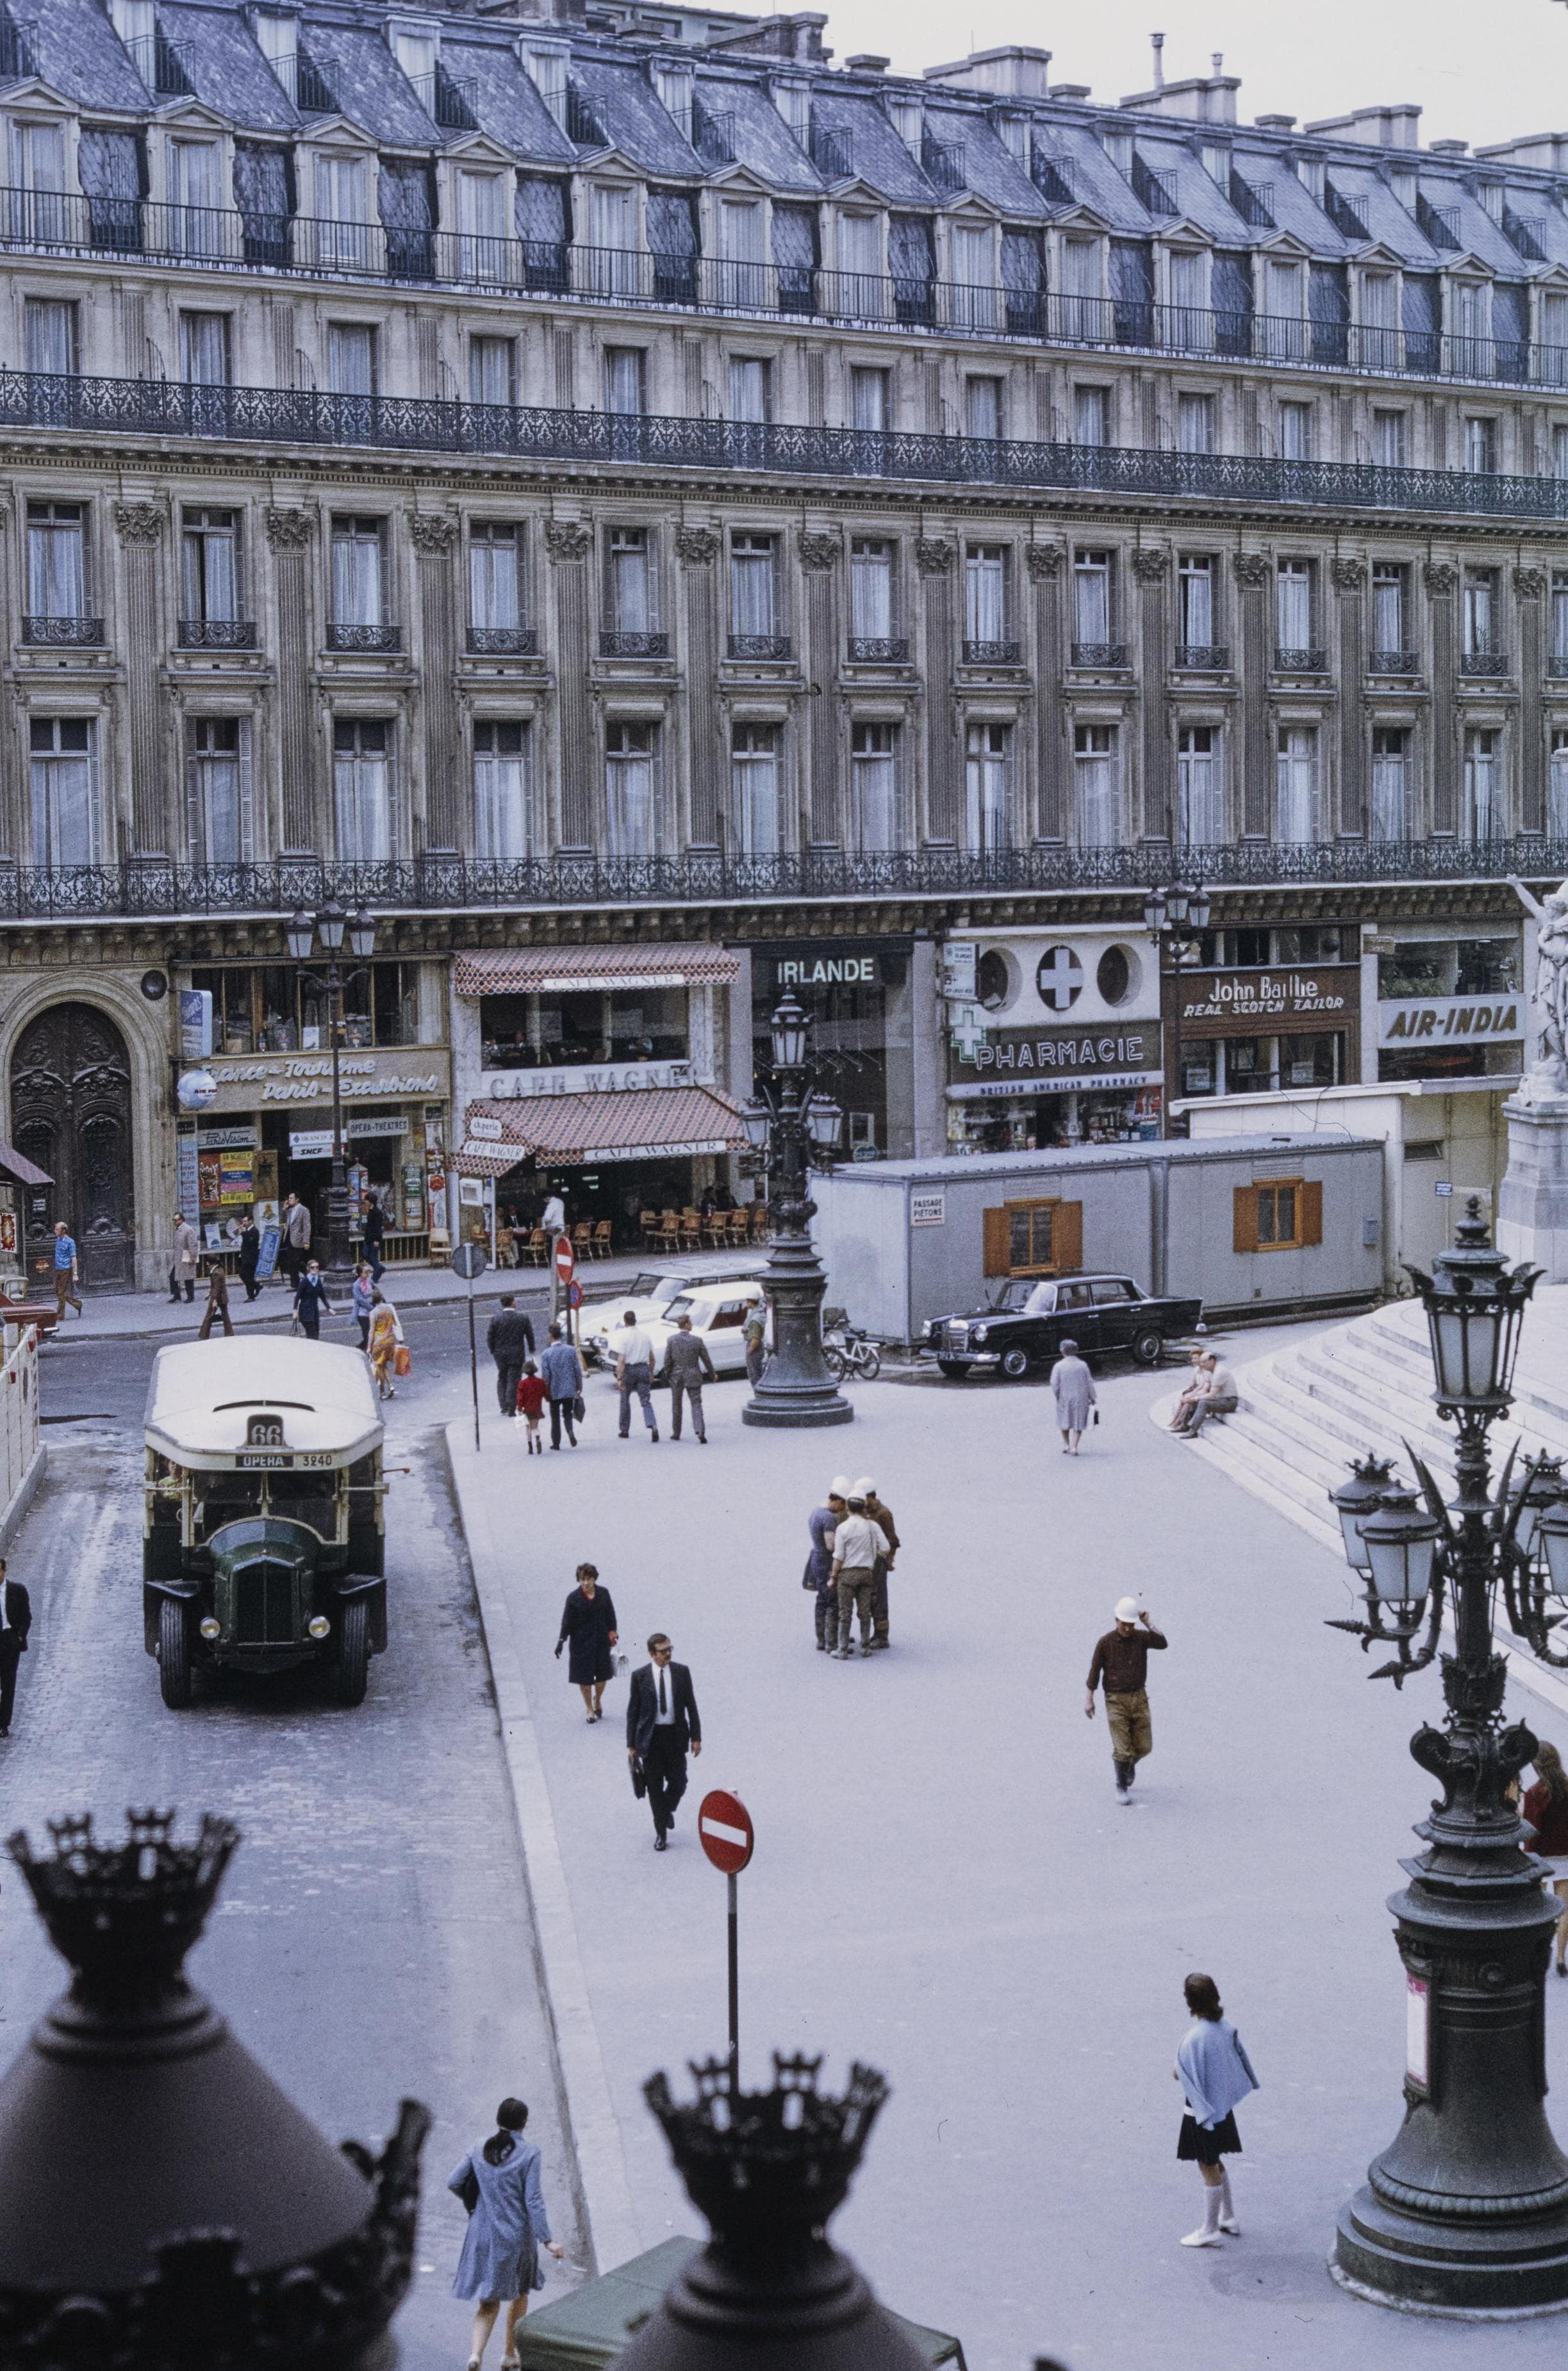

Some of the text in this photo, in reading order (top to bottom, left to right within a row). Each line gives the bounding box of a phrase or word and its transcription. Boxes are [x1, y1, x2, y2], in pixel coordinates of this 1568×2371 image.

[603, 976, 673, 986] WAGNER
[778, 959, 874, 984] IRLANDE
[1209, 975, 1318, 1002] John Baillie
[1184, 996, 1344, 1017] REAL SCOTCH TAILOR
[1386, 1005, 1517, 1039] AIR-INDIA
[977, 1037, 1144, 1070] PHARMACIE
[584, 1066, 697, 1092] WAGNER
[980, 1077, 1147, 1095] BRITISH AMERICAN PHARMACY
[645, 1142, 716, 1154] WAGNER
[914, 1199, 942, 1207] PASSAGE
[252, 1425, 281, 1446] 66
[243, 1456, 284, 1466] OPERA
